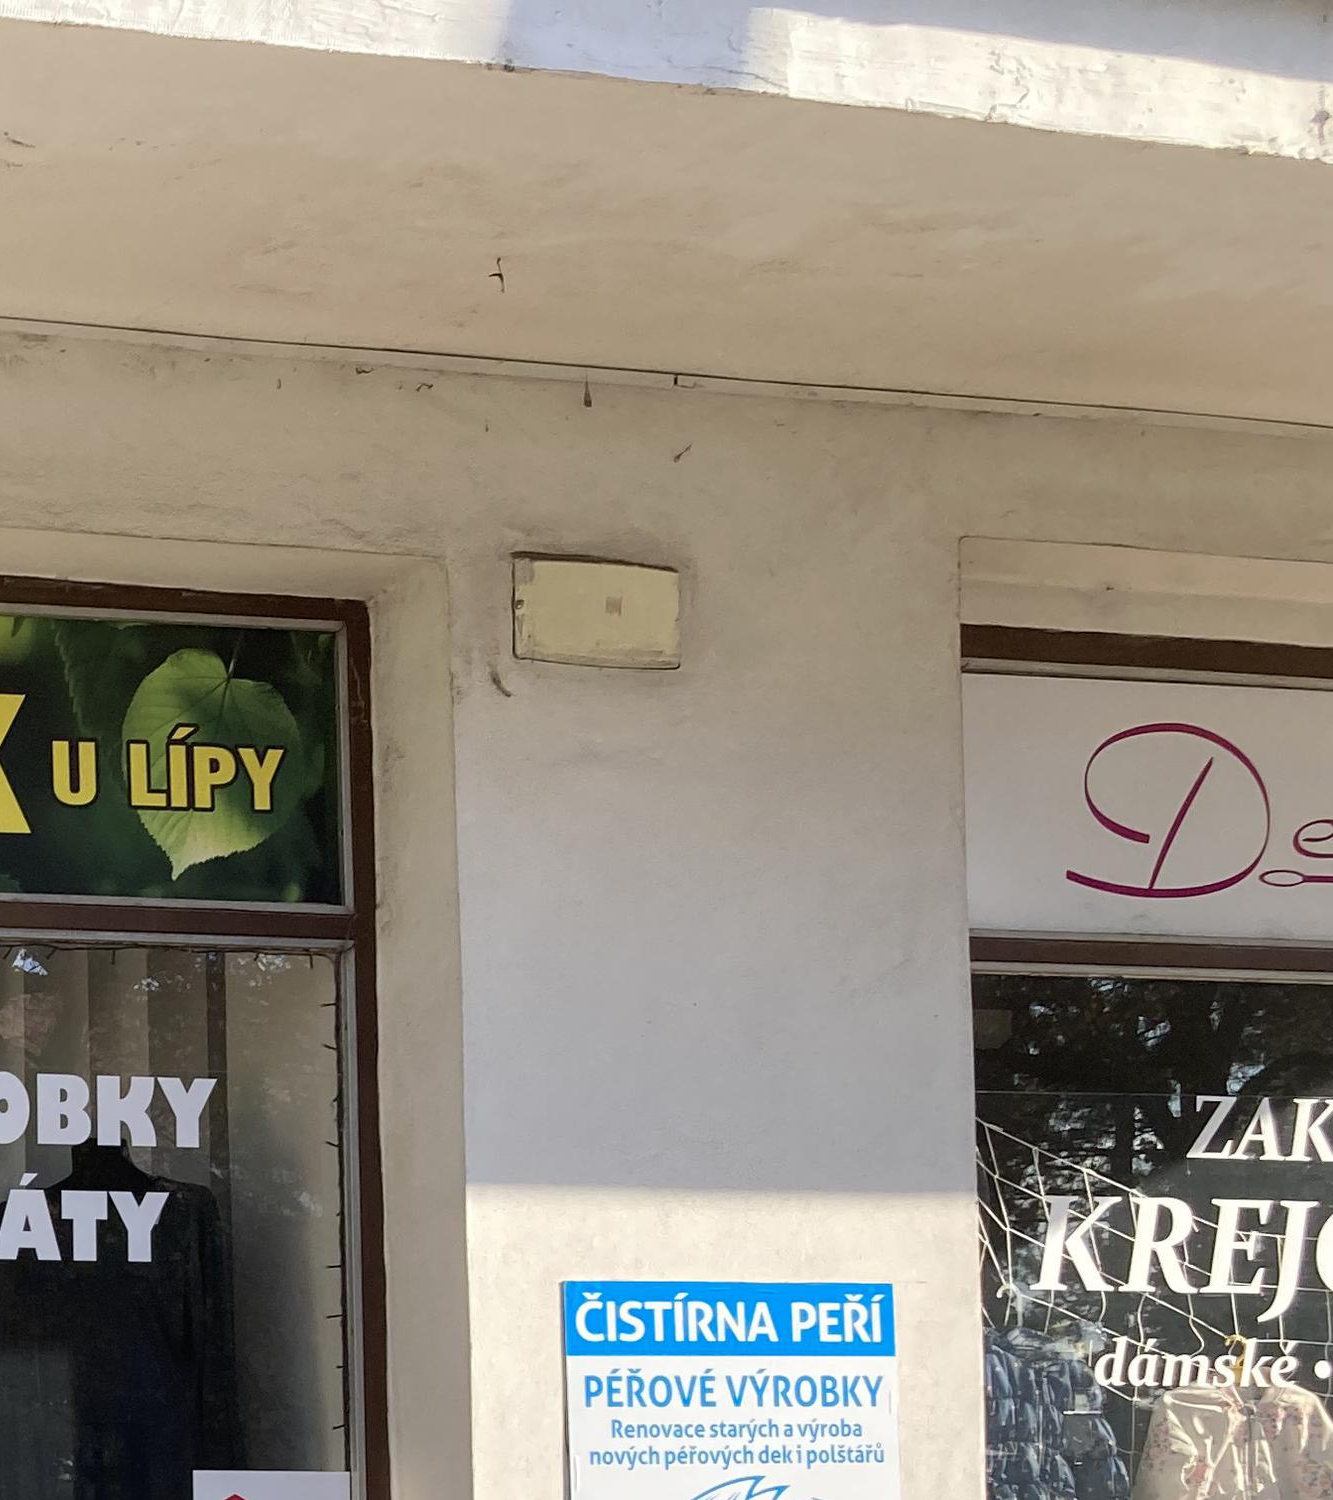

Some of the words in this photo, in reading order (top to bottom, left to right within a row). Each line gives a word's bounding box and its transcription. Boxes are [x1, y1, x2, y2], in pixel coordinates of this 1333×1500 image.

[50, 738, 99, 809] U
[129, 721, 287, 813] LÍPY
[1030, 1195, 1333, 1323] KREJ
[575, 1292, 779, 1342] ČISTÍRNA
[791, 1293, 885, 1343] PEŘÍ
[585, 1368, 717, 1407] PÉŘOVÉ
[725, 1368, 883, 1407] VÝROBKY
[1094, 1336, 1300, 1389] dámské
[589, 1445, 661, 1470] nových
[664, 1445, 754, 1470] péřových
[758, 1445, 793, 1464] dek
[805, 1442, 885, 1469] polštářů
[611, 1419, 705, 1438] Renovace
[710, 1418, 780, 1444] starých
[783, 1424, 794, 1437] a
[797, 1417, 862, 1442] výroba
